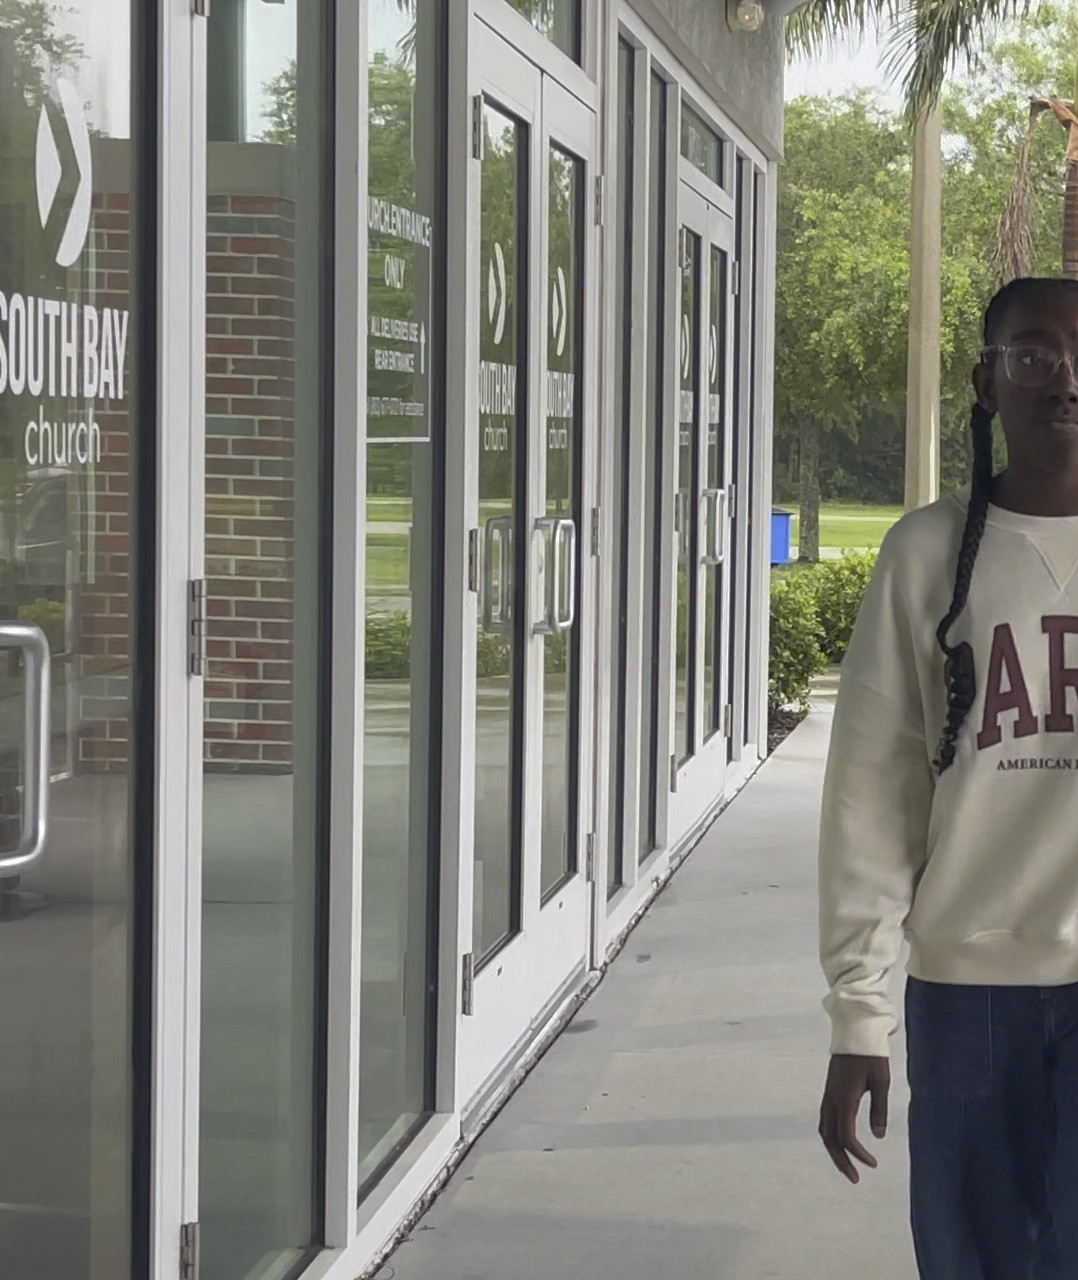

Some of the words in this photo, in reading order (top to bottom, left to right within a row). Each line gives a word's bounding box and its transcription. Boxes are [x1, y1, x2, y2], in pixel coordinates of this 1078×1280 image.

[391, 204, 430, 247] ENTRANCE
[384, 254, 405, 289] ONLY
[83, 304, 129, 400] BAY
[480, 360, 501, 414] OUTH
[502, 364, 517, 415] BAY
[25, 404, 100, 465] church
[484, 419, 508, 450] church
[997, 758, 1073, 771] AMERICAN
